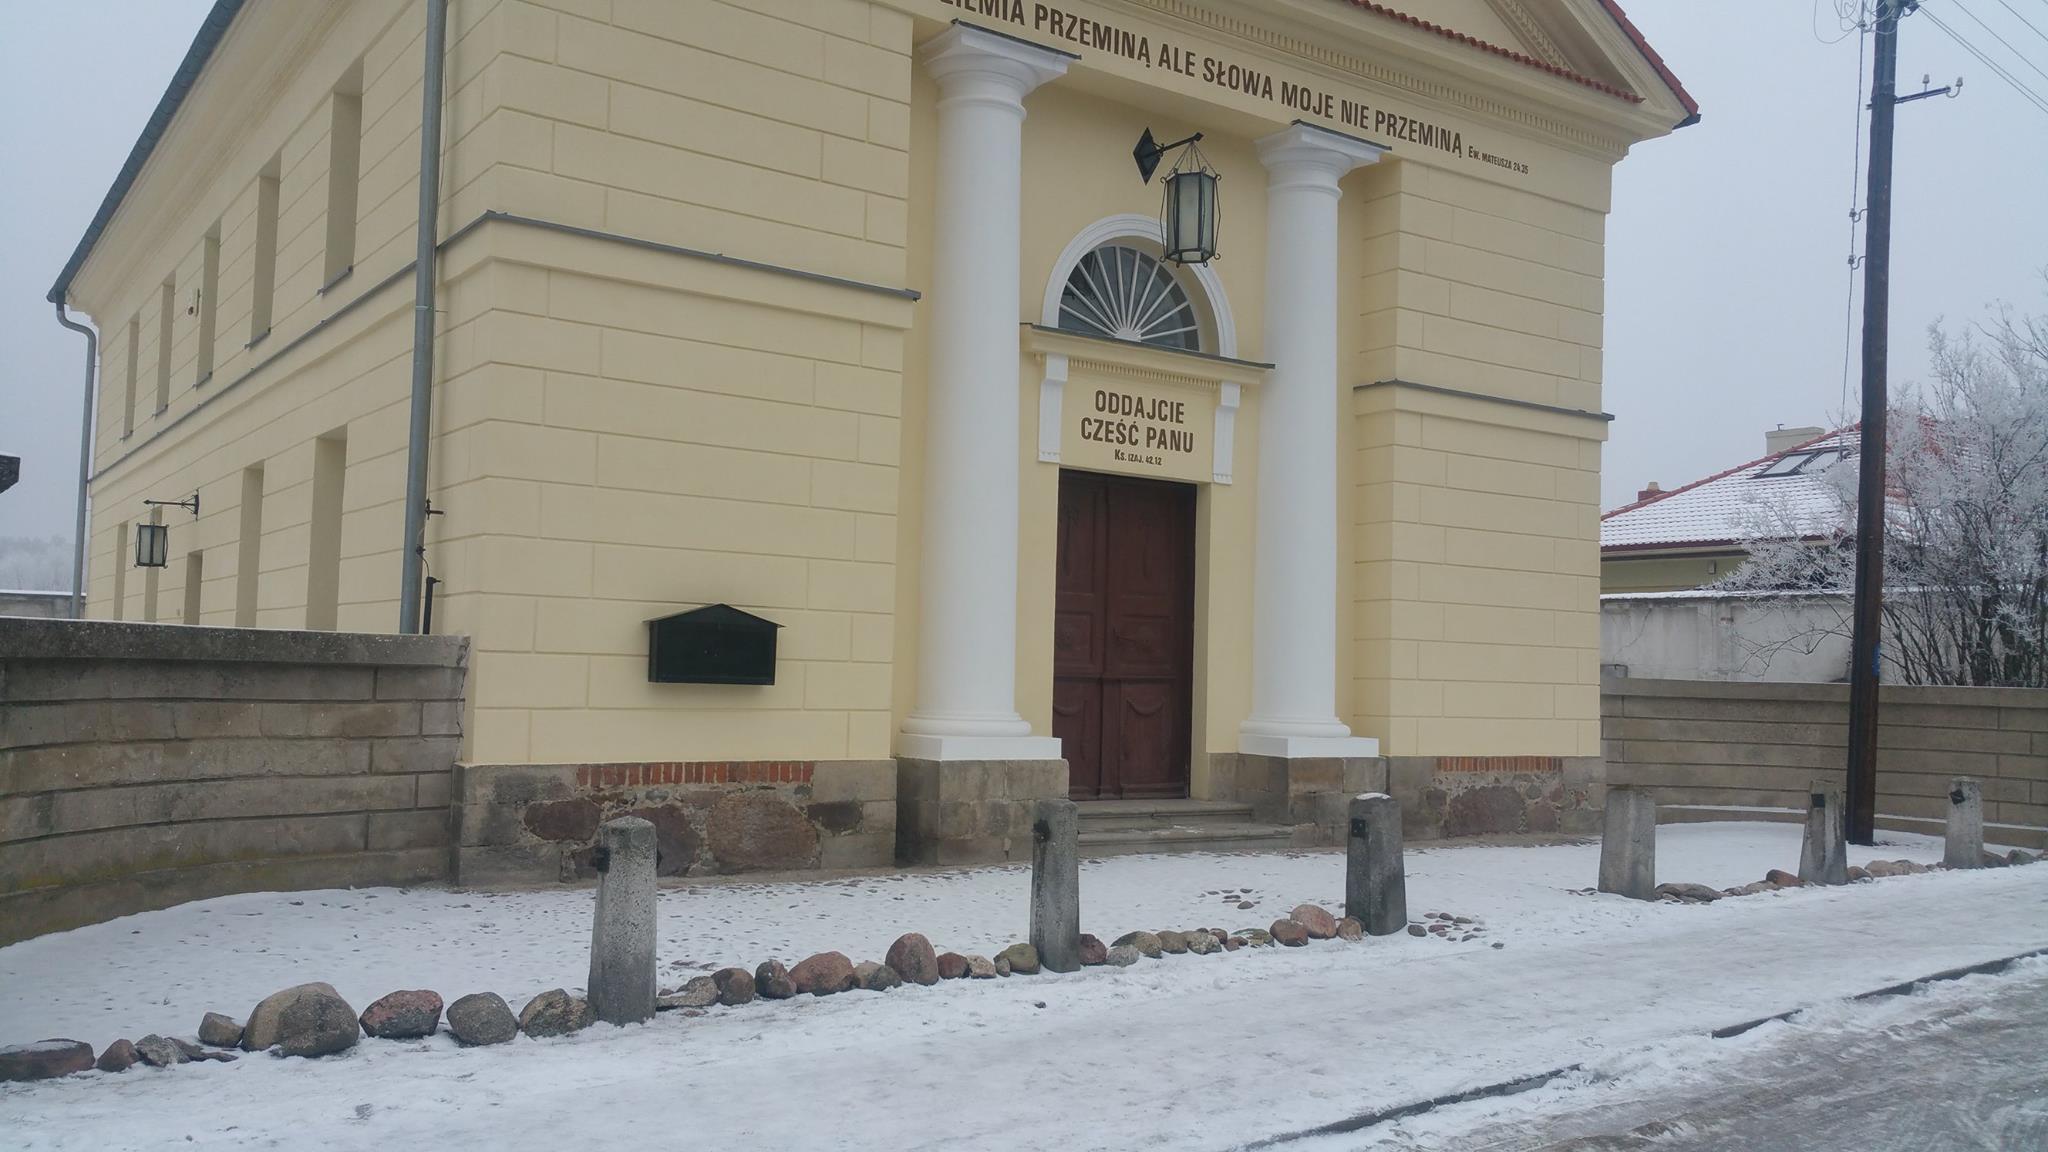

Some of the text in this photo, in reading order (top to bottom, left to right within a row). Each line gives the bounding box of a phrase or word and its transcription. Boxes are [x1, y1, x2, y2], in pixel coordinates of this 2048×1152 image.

[939, 0, 1025, 26] MIA
[1034, 3, 1151, 68] PRZEMINĄ
[1158, 43, 1196, 77] ALE
[1202, 57, 1274, 101] SŁOWA
[1280, 81, 1334, 119] MOJE
[1340, 99, 1369, 130] NIE
[1374, 110, 1463, 158] PRZEMINĄ
[1481, 152, 1512, 170] MATEUSZA
[1095, 390, 1185, 424] ODDAJCIE
[1080, 417, 1194, 453] CZEŚĆ PANU
